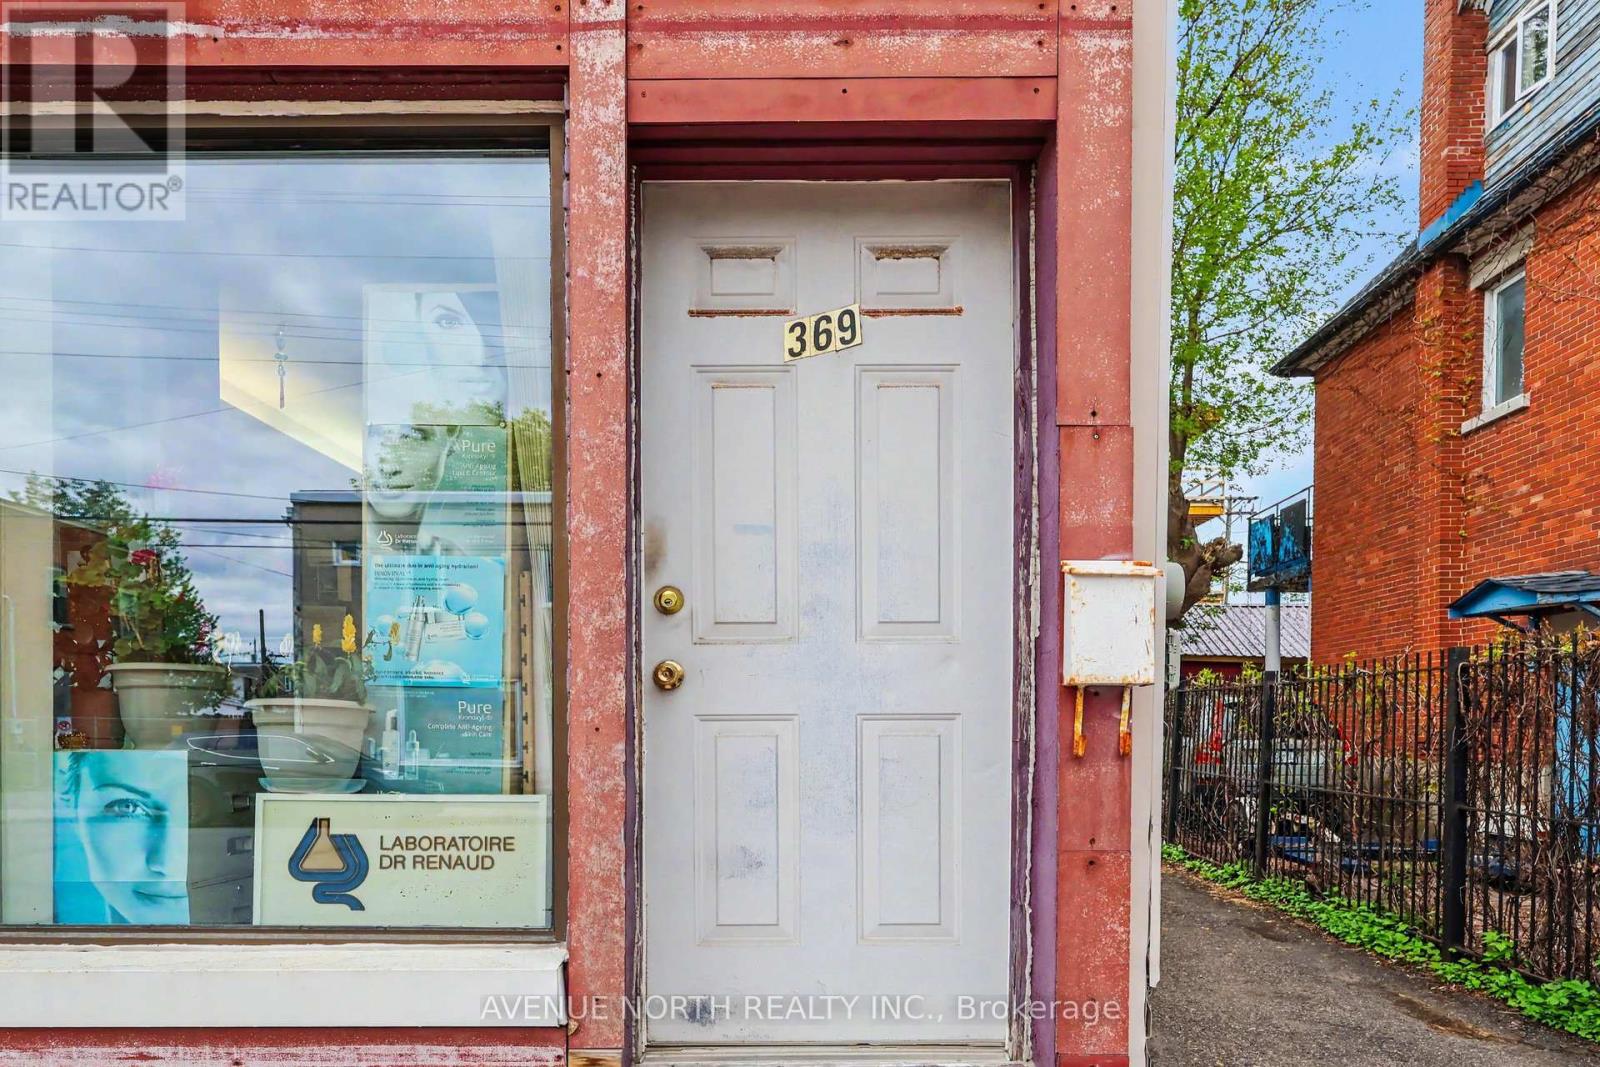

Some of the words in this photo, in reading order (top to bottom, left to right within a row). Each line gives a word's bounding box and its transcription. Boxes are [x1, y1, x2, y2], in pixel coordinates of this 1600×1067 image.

[787, 308, 857, 358] 369
[462, 439, 496, 453] Pure
[458, 700, 493, 714] Pure
[379, 835, 516, 851] LABORATOIRE
[379, 854, 406, 870] DR
[412, 854, 496, 870] RENAUD
